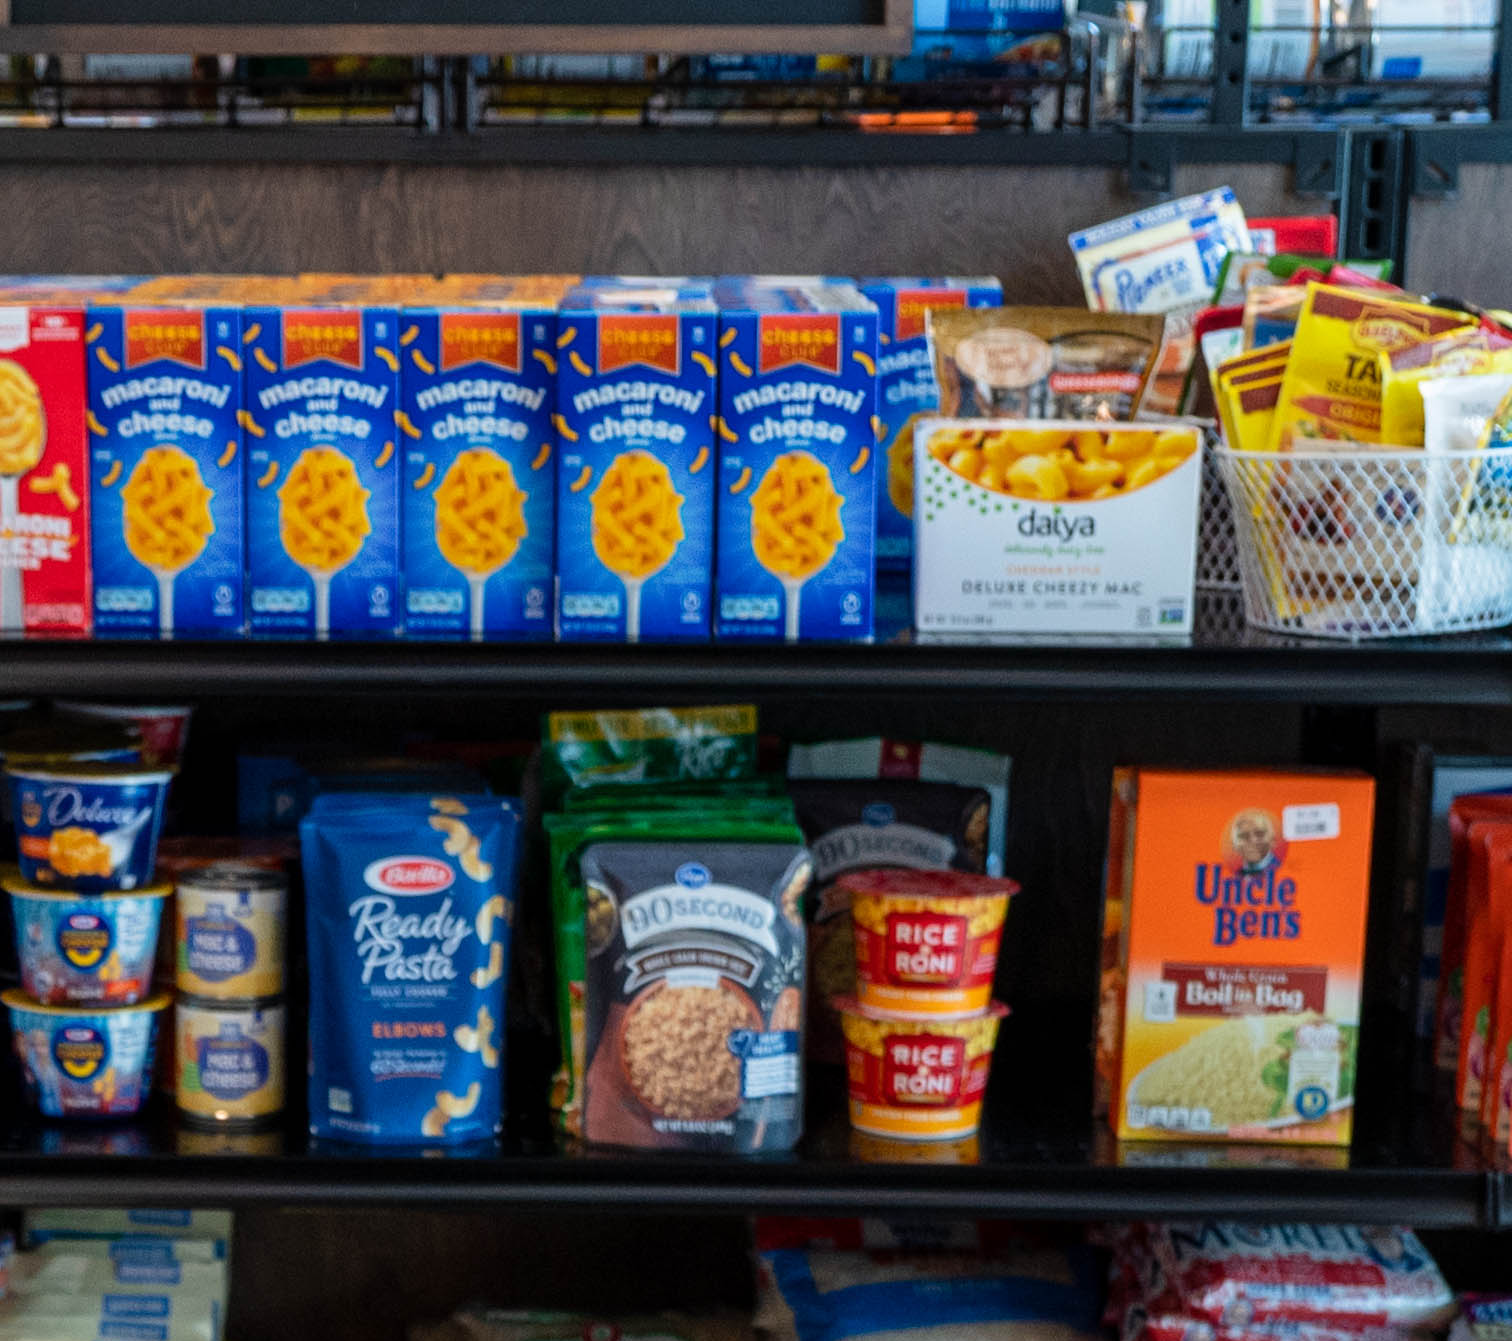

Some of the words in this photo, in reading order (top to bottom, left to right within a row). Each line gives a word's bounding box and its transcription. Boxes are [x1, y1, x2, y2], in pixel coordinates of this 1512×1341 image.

[102, 375, 230, 410] macaroni
[149, 399, 179, 413] and
[733, 379, 863, 415] macaroni
[782, 403, 813, 418] and
[118, 413, 214, 439] cheese
[749, 417, 846, 446] cheese
[1018, 509, 1096, 540] daiya
[962, 579, 1024, 596] DELUXE
[1029, 579, 1092, 596] CHEEZY
[1099, 580, 1143, 596] MAC
[1195, 864, 1296, 908] Uncle
[350, 898, 473, 947] Ready
[626, 901, 674, 932] 90
[677, 902, 764, 931] SECOND
[1214, 904, 1302, 946] Ben's
[895, 922, 958, 946] RICE
[358, 940, 458, 984] Pasta
[1186, 983, 1231, 1007] Boil
[1255, 985, 1304, 1011] Bag
[372, 1021, 446, 1038] ELBOWS
